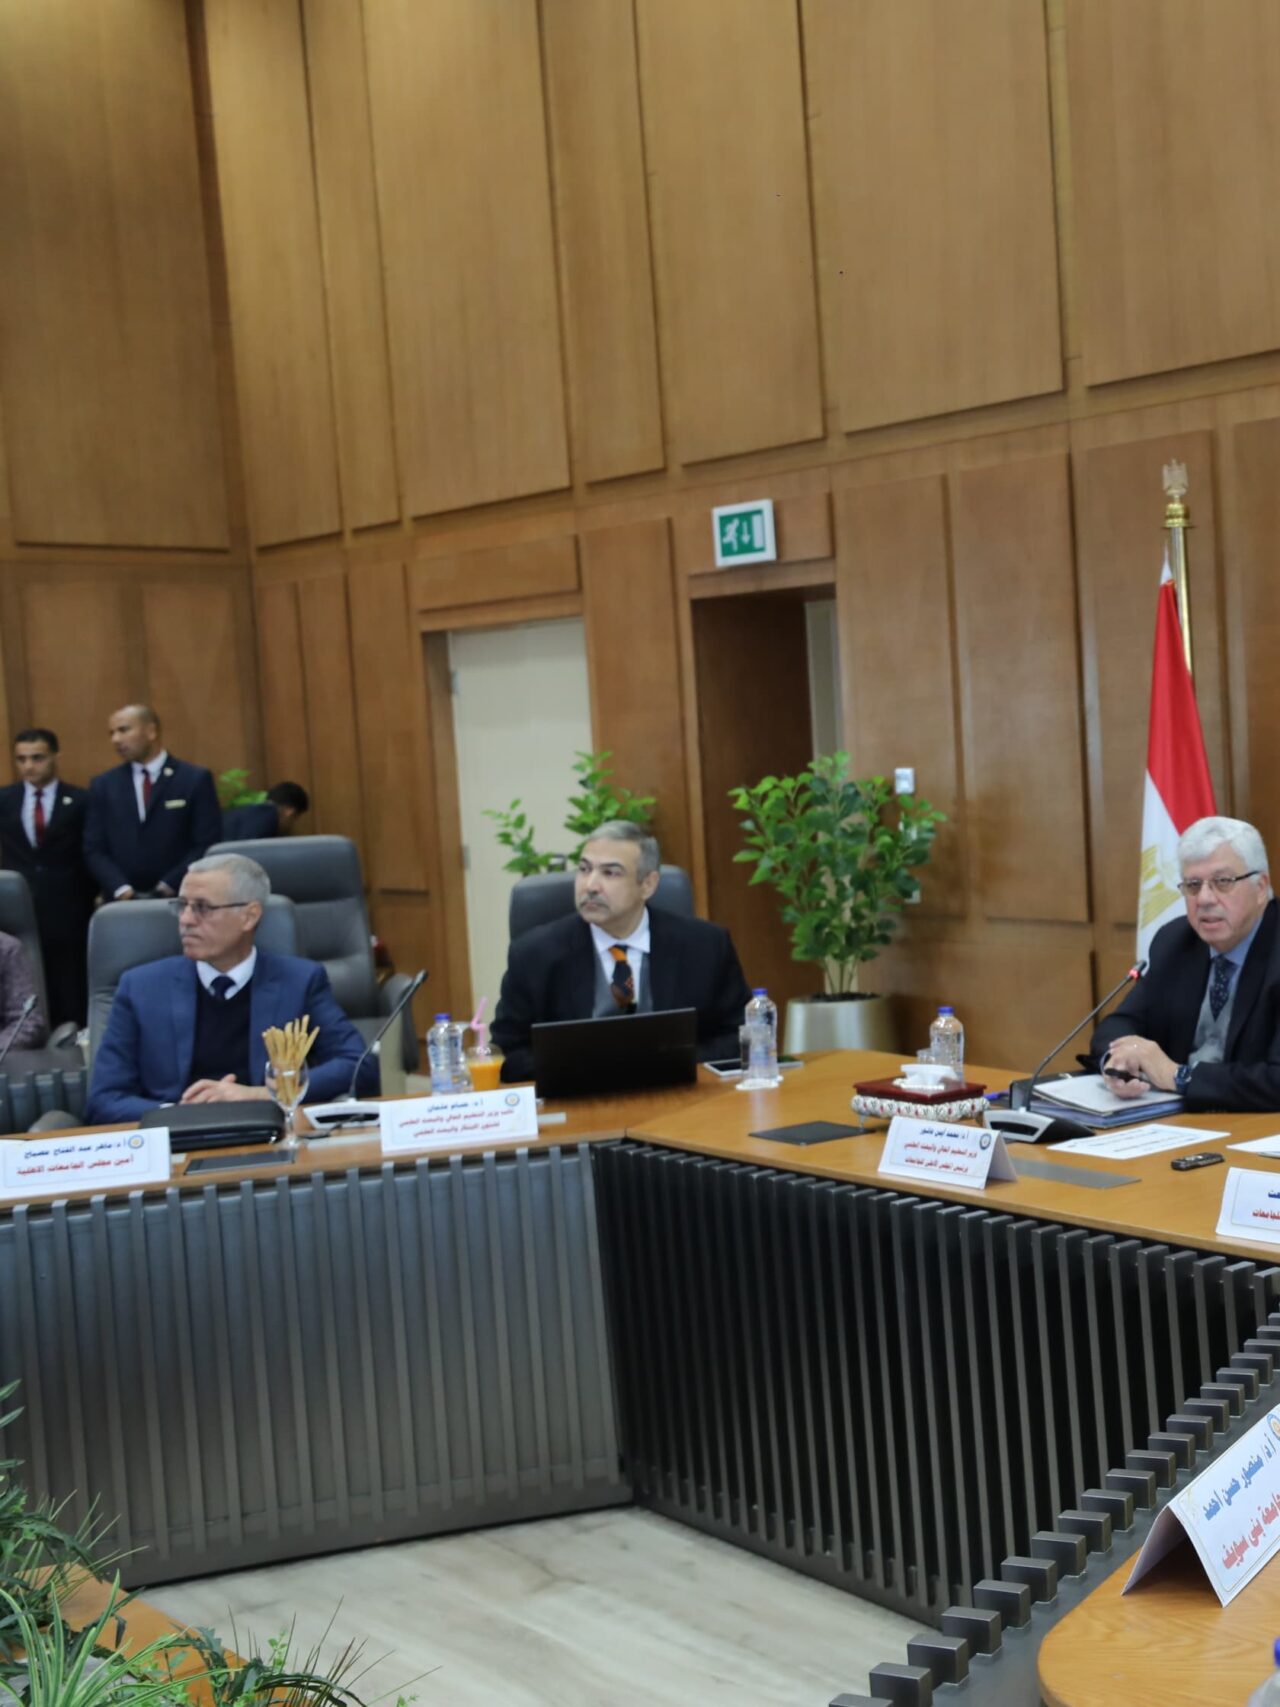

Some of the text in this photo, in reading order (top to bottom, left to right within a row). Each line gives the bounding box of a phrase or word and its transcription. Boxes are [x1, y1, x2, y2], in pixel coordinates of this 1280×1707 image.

[1241, 1453, 1265, 1489] منصور
[1221, 1477, 1242, 1507] حسن
[1221, 1534, 1250, 1570] سويف
